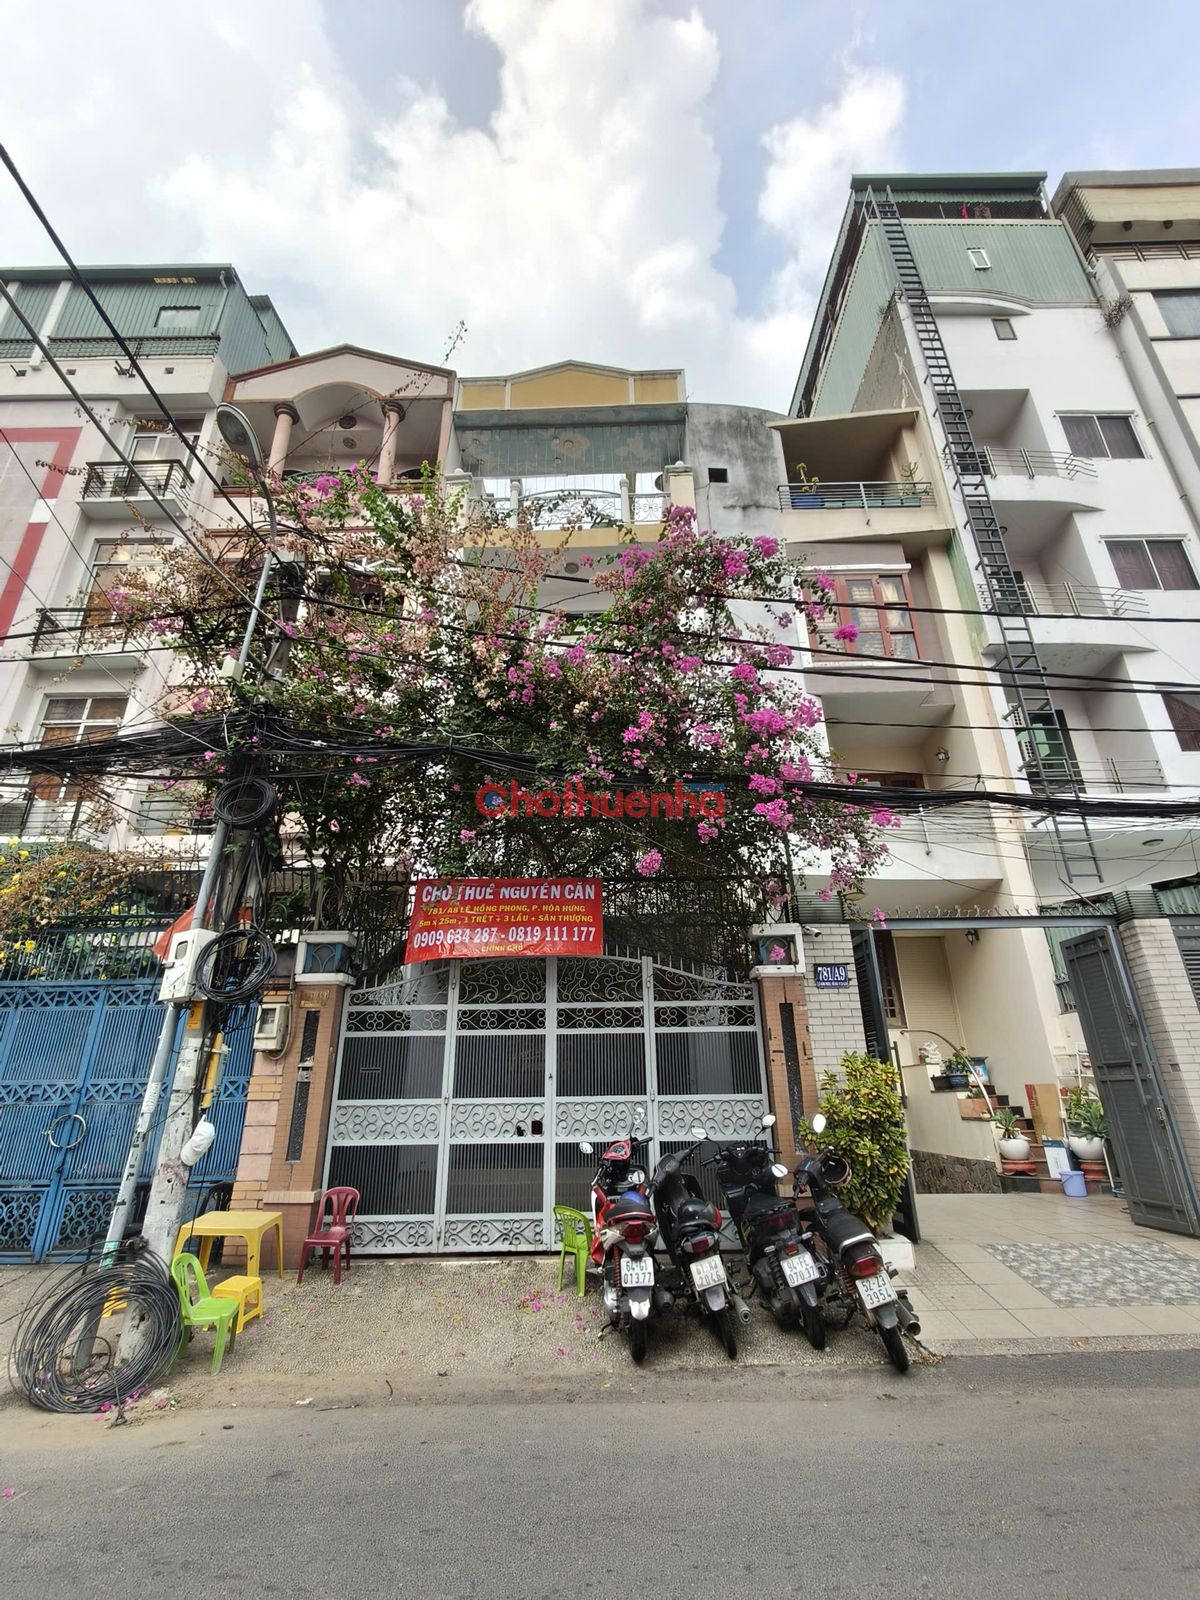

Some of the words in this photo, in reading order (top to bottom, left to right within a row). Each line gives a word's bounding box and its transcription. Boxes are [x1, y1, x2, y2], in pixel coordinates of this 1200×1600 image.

[456, 883, 495, 901] THUÊ
[499, 882, 561, 900] NGUYÊN
[564, 881, 596, 900] CĂN
[460, 904, 471, 914] LÊ
[532, 904, 542, 912] P.
[562, 904, 586, 912] HƯNG
[419, 918, 431, 928] 5m
[438, 917, 457, 926] 25m
[471, 915, 493, 924] TRỆT
[538, 912, 557, 922] SÂN
[557, 914, 593, 923] THƯỢNG
[413, 930, 444, 949] 0909
[446, 927, 472, 944] 634
[473, 927, 499, 944] 287
[508, 926, 542, 943] 0819
[544, 926, 569, 942] 111
[572, 926, 596, 942] 177
[817, 966, 846, 981] 781/A9
[867, 1287, 894, 1306] 3954
